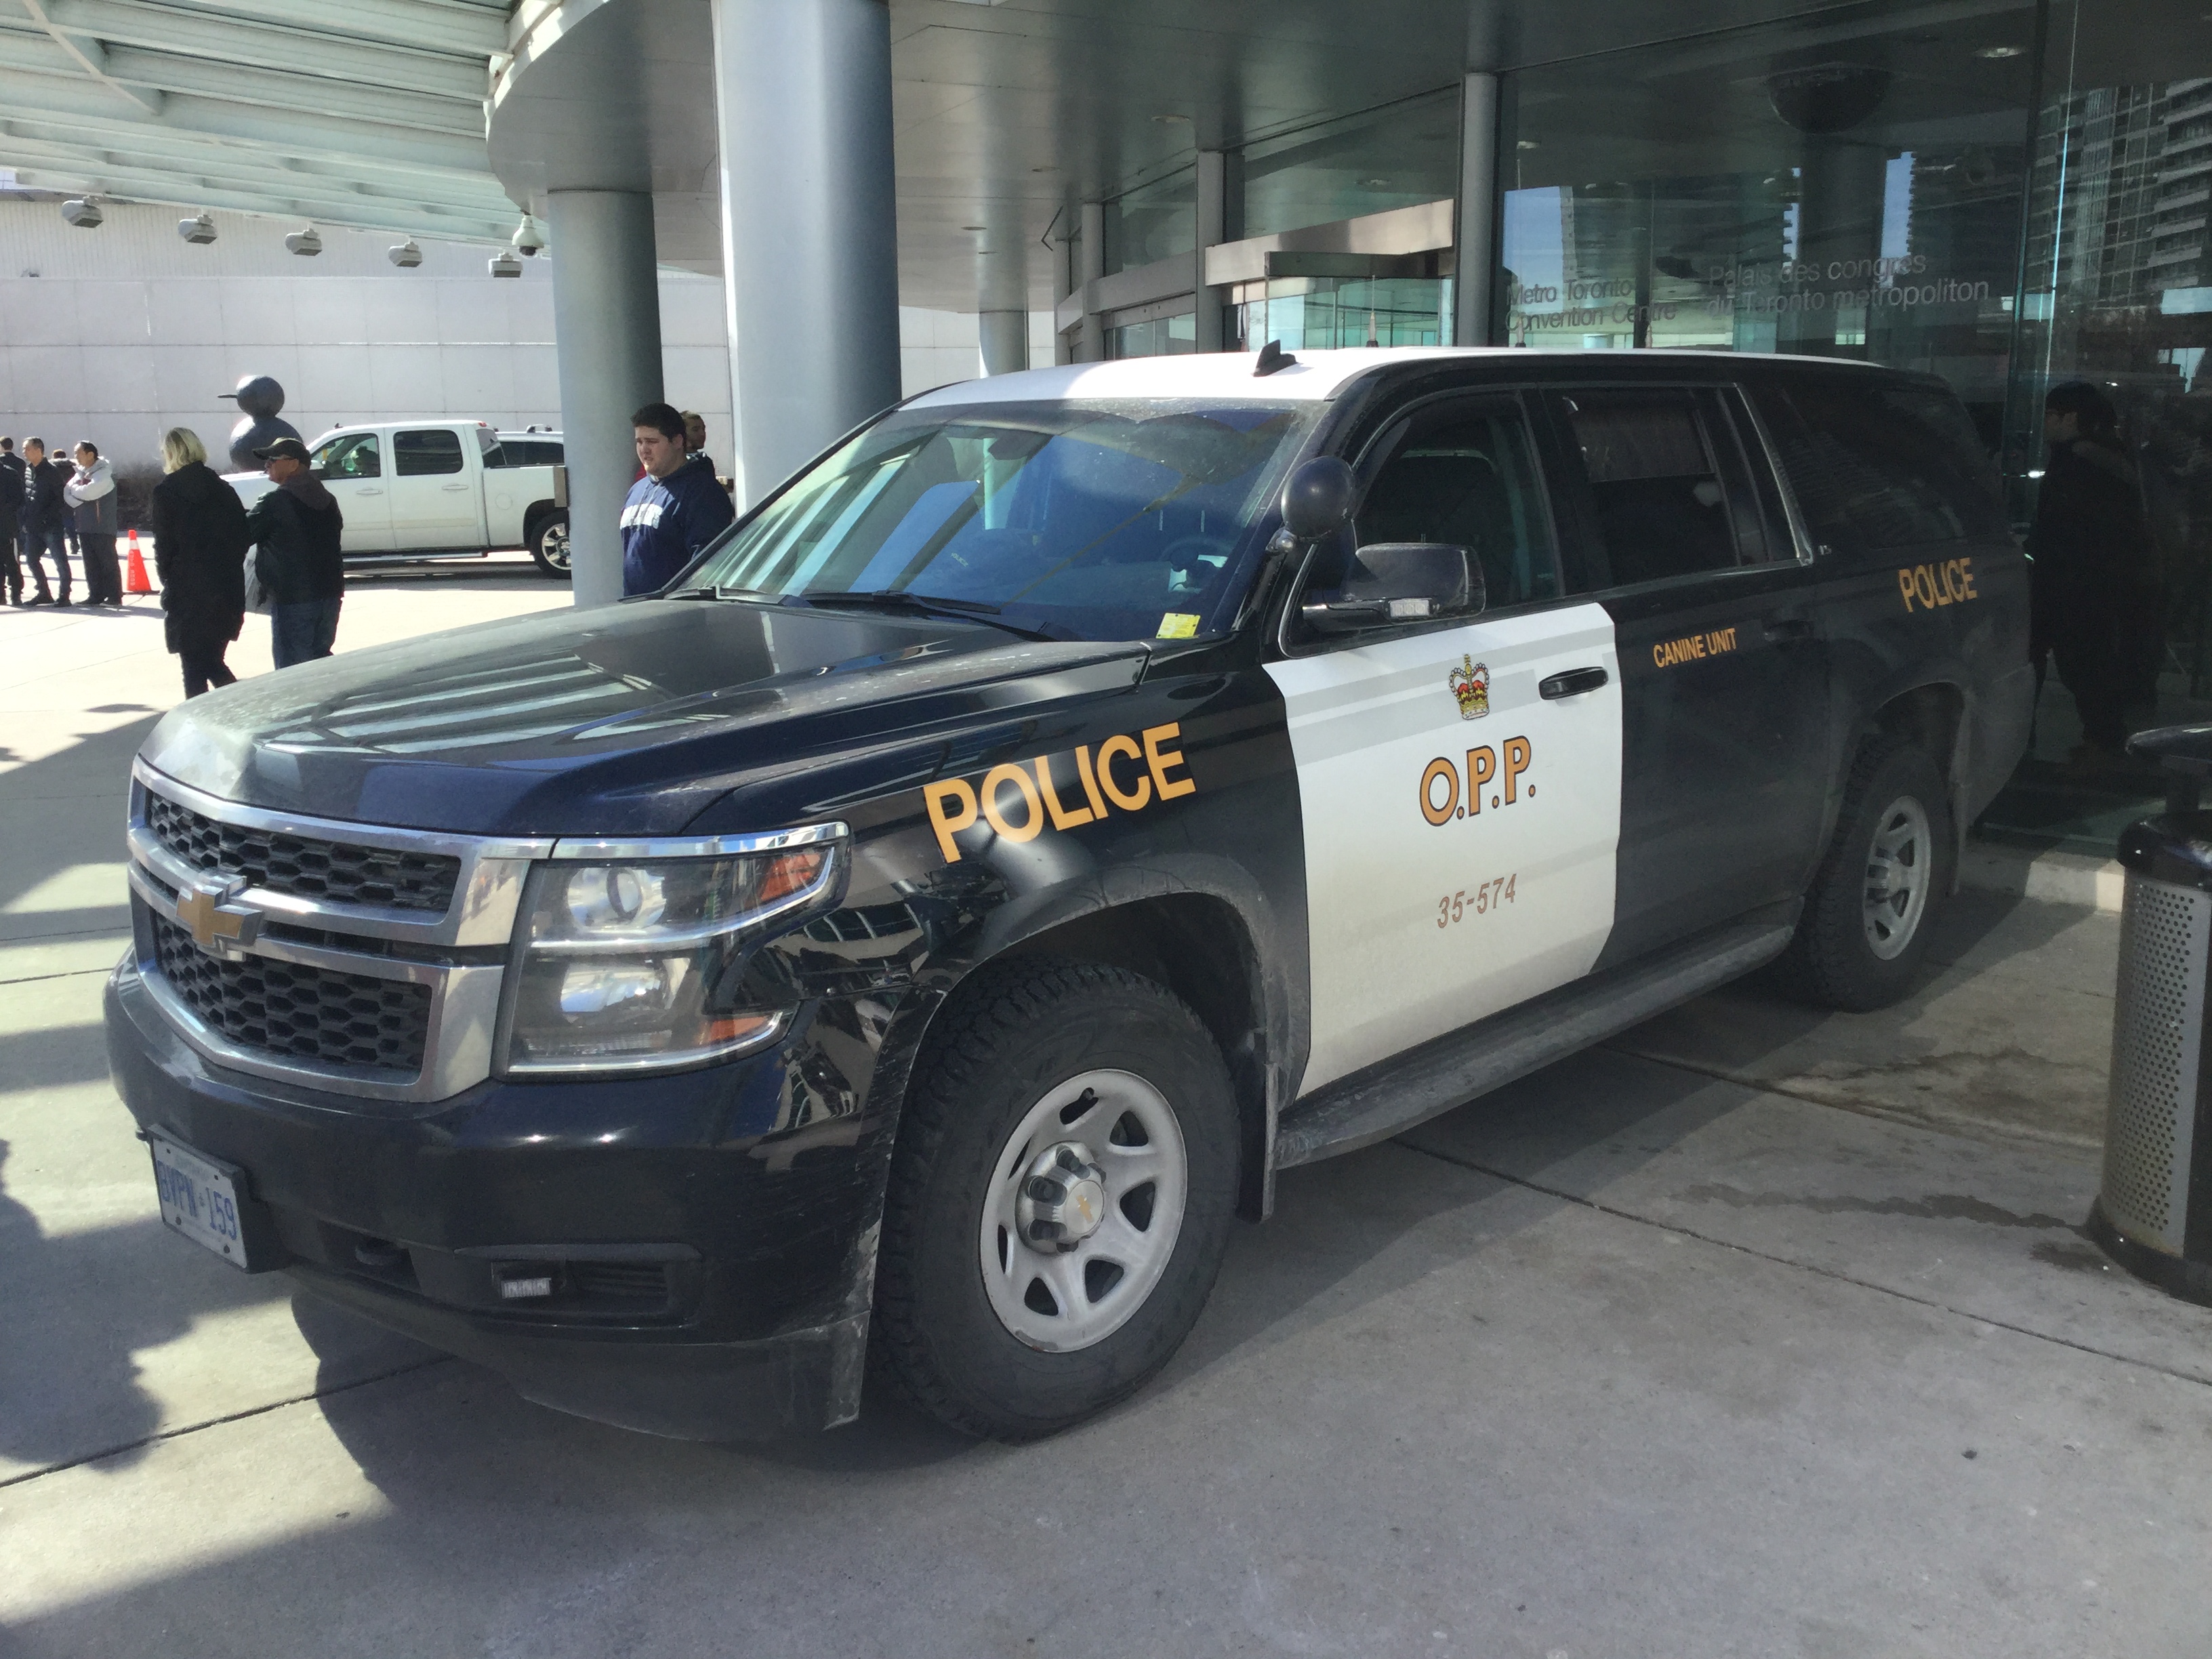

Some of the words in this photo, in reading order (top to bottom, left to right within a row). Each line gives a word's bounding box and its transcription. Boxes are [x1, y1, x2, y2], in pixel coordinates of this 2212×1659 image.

[1507, 283, 1557, 306] Metro
[1564, 276, 1633, 301] Toronto
[1710, 262, 1771, 287] Palais
[1780, 260, 1820, 284] des
[1506, 306, 1603, 331] Convention
[1611, 300, 1677, 324] Centre
[1707, 294, 1733, 316] du
[1741, 289, 1825, 314] Toronto
[1898, 557, 1977, 613] POLICE
[1654, 635, 1706, 668] CANINE
[1706, 628, 1736, 655] UNIT
[923, 722, 1196, 863] POLICE
[1420, 735, 1536, 827] O.P.P.
[1437, 874, 1517, 928] 35-574
[205, 1187, 237, 1240] 159
